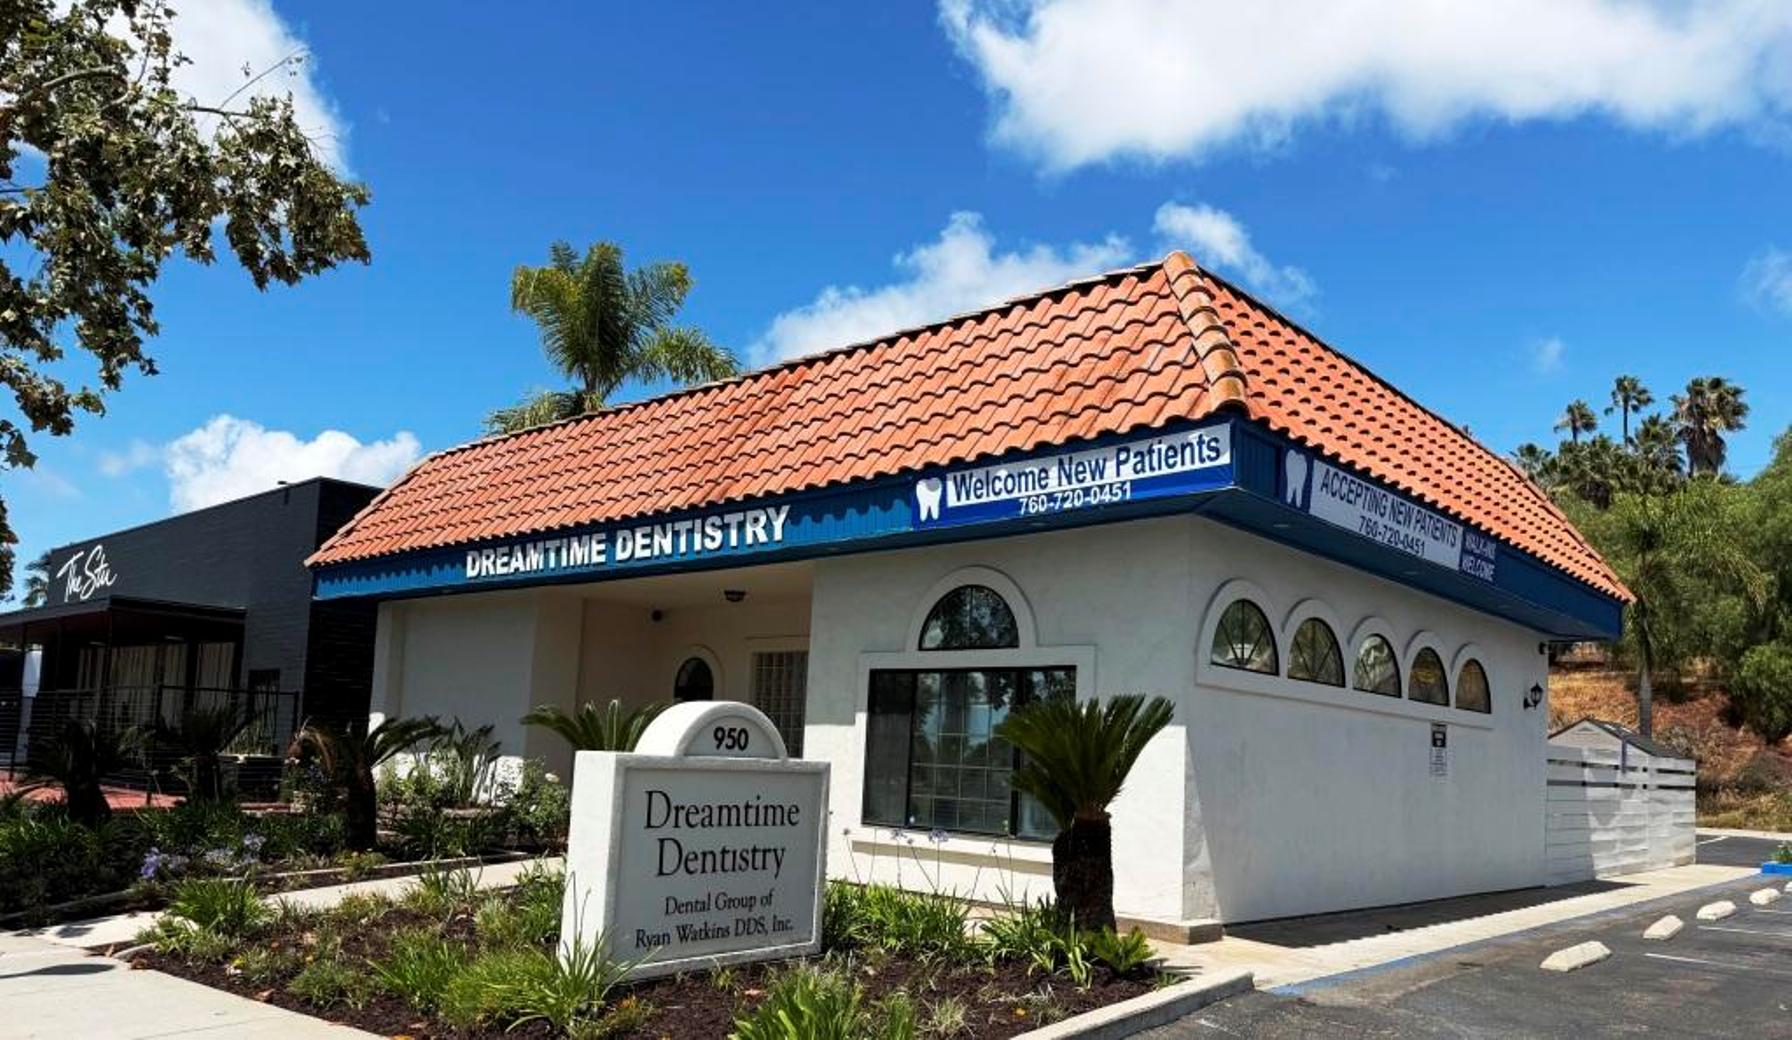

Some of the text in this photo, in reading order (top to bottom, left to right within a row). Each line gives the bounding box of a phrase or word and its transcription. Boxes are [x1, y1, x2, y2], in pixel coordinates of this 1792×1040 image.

[953, 434, 1221, 502] Welcome New Patients
[1019, 481, 1131, 515] 760-720-0451
[1320, 468, 1389, 519] ACCEPTING
[1389, 501, 1414, 526] NEW
[1413, 508, 1458, 548] PATIENTS
[466, 505, 790, 578] DREAMTIME DENTISTRY
[1358, 515, 1426, 557] 760-720-0451
[56, 551, 85, 602] The
[713, 727, 749, 750] 950
[644, 790, 800, 830] Dreamtime
[664, 889, 774, 916] Dental Group of
[635, 915, 793, 951] Ryan Watkins DDS, Inc.
